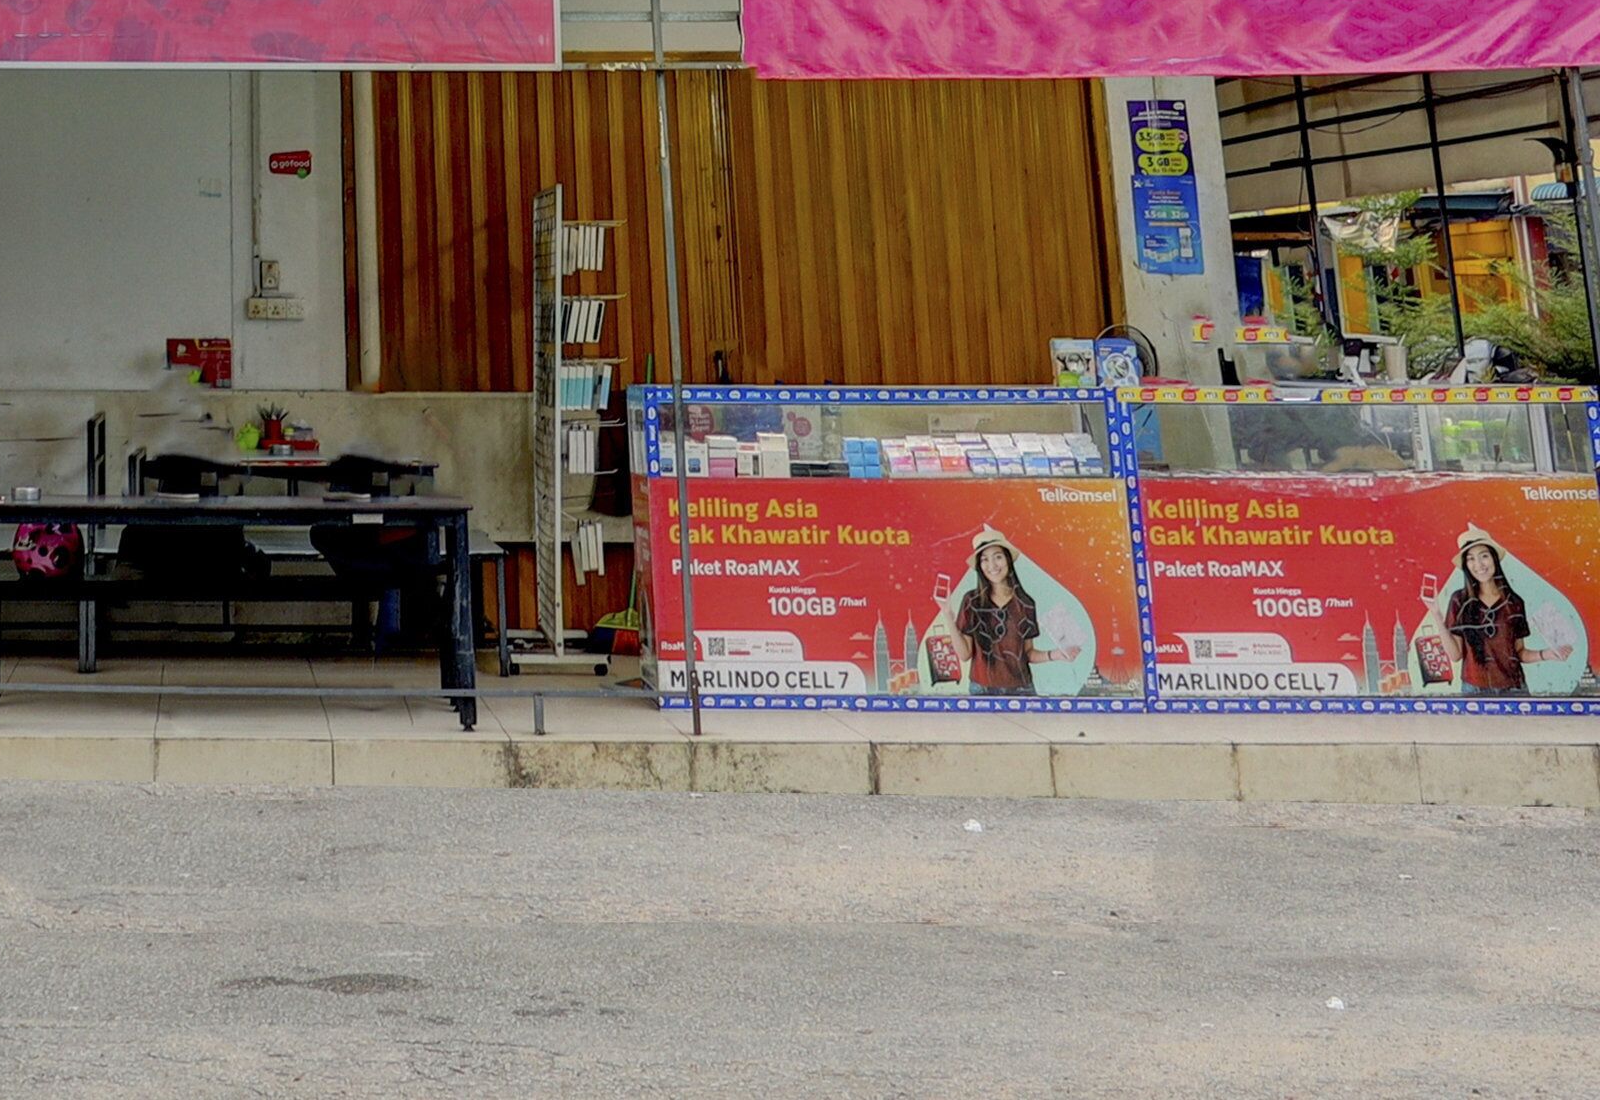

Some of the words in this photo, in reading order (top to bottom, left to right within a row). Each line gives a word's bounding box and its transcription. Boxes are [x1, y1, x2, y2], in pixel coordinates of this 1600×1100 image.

[279, 159, 310, 169] gofood
[1038, 488, 1117, 502] Telkomsel
[1520, 486, 1598, 500] Telkomse
[668, 498, 759, 522] Keliling
[766, 498, 818, 518] Asia
[1148, 498, 1240, 524] Keliling
[1246, 500, 1298, 519] Asia
[721, 524, 830, 545] Khawatir
[838, 525, 910, 546] Kuota
[1150, 526, 1196, 546] Gak
[1204, 526, 1312, 546] Khawatir
[1320, 526, 1394, 546] Kuota
[726, 559, 800, 576] RoaMAX
[1154, 560, 1204, 578] Paket
[1208, 560, 1283, 578] RoaMAX
[768, 586, 790, 594] Kuota
[791, 586, 816, 596] Hingga
[1276, 588, 1302, 596] Hingga
[768, 596, 837, 616] 100GB
[1252, 598, 1323, 617] 100GB
[660, 640, 698, 651] RoaMX
[785, 670, 834, 688] CELL
[838, 672, 849, 688] 7
[1158, 673, 1269, 690] MARLINDO
[1274, 673, 1326, 690] CELL
[1328, 674, 1338, 690] 7
